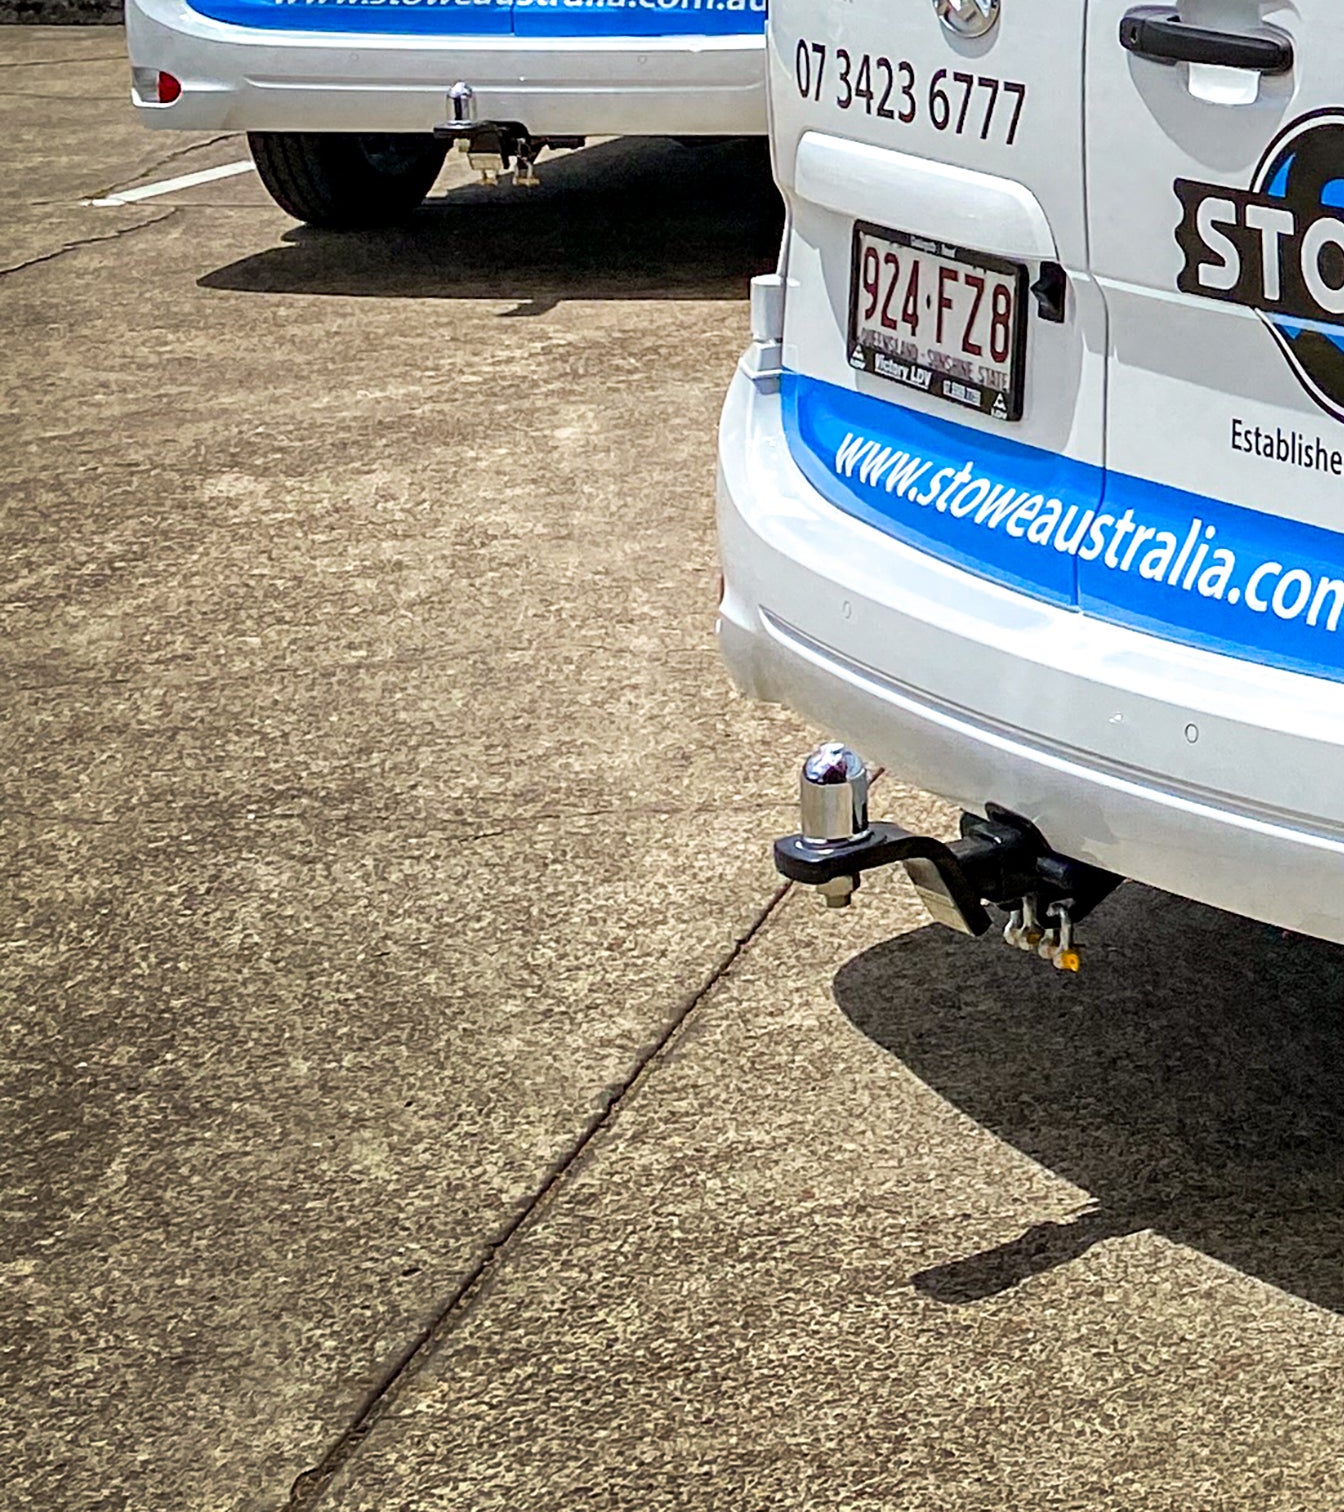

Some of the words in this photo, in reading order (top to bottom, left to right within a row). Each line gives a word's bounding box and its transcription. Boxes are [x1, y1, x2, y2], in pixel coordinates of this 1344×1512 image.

[795, 38, 827, 102] 07
[835, 48, 917, 124] 3423
[928, 68, 1027, 146] 6777
[873, 352, 910, 380] Victory
[910, 364, 933, 390] LDV
